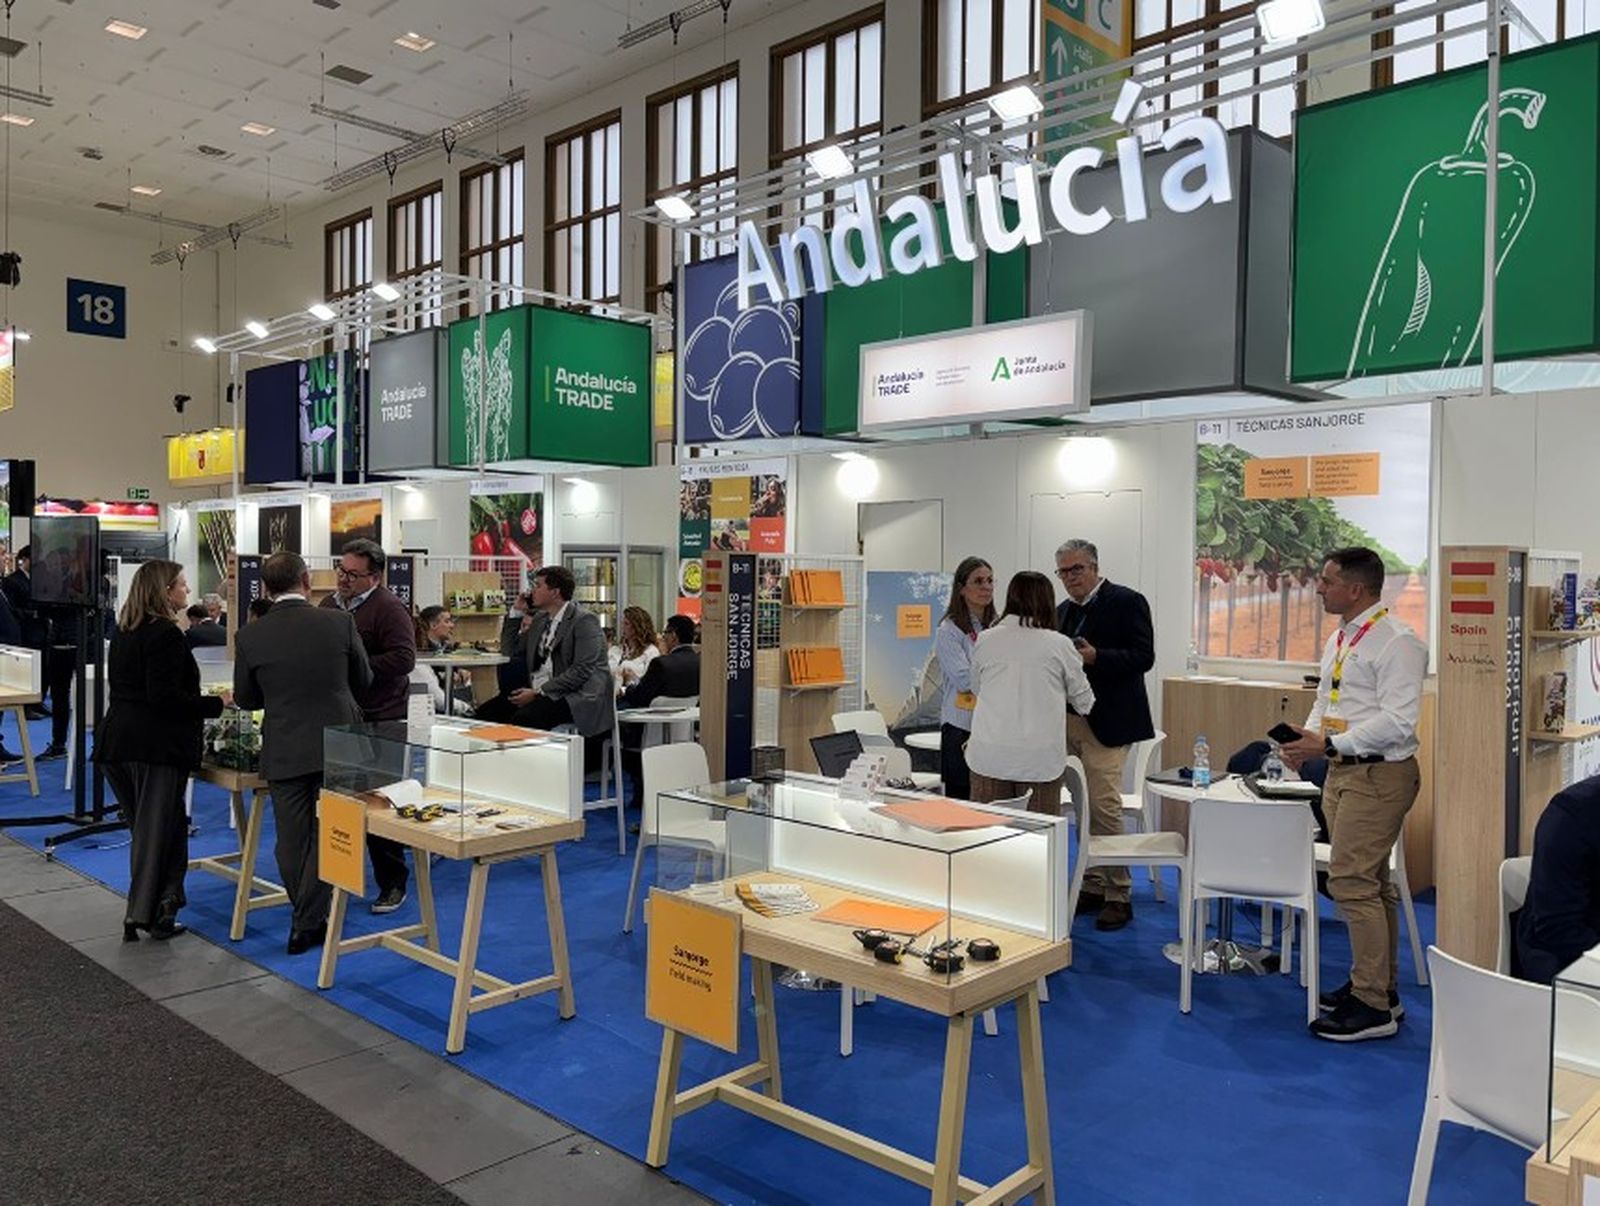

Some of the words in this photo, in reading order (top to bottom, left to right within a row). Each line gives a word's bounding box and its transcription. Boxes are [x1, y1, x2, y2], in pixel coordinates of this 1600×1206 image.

[736, 78, 1233, 310] Andalucía
[78, 293, 116, 325] 18
[554, 366, 638, 395] Andalucía
[878, 367, 924, 385] Andalucía
[380, 381, 428, 405] Andalucía
[555, 389, 615, 412] TRADE
[878, 383, 910, 397] TRADE
[381, 402, 413, 423] TRADE
[1236, 417, 1294, 433] TÉCNICAS
[729, 593, 740, 625] SAN
[1450, 623, 1488, 636] Spain
[726, 628, 740, 681] JORGE
